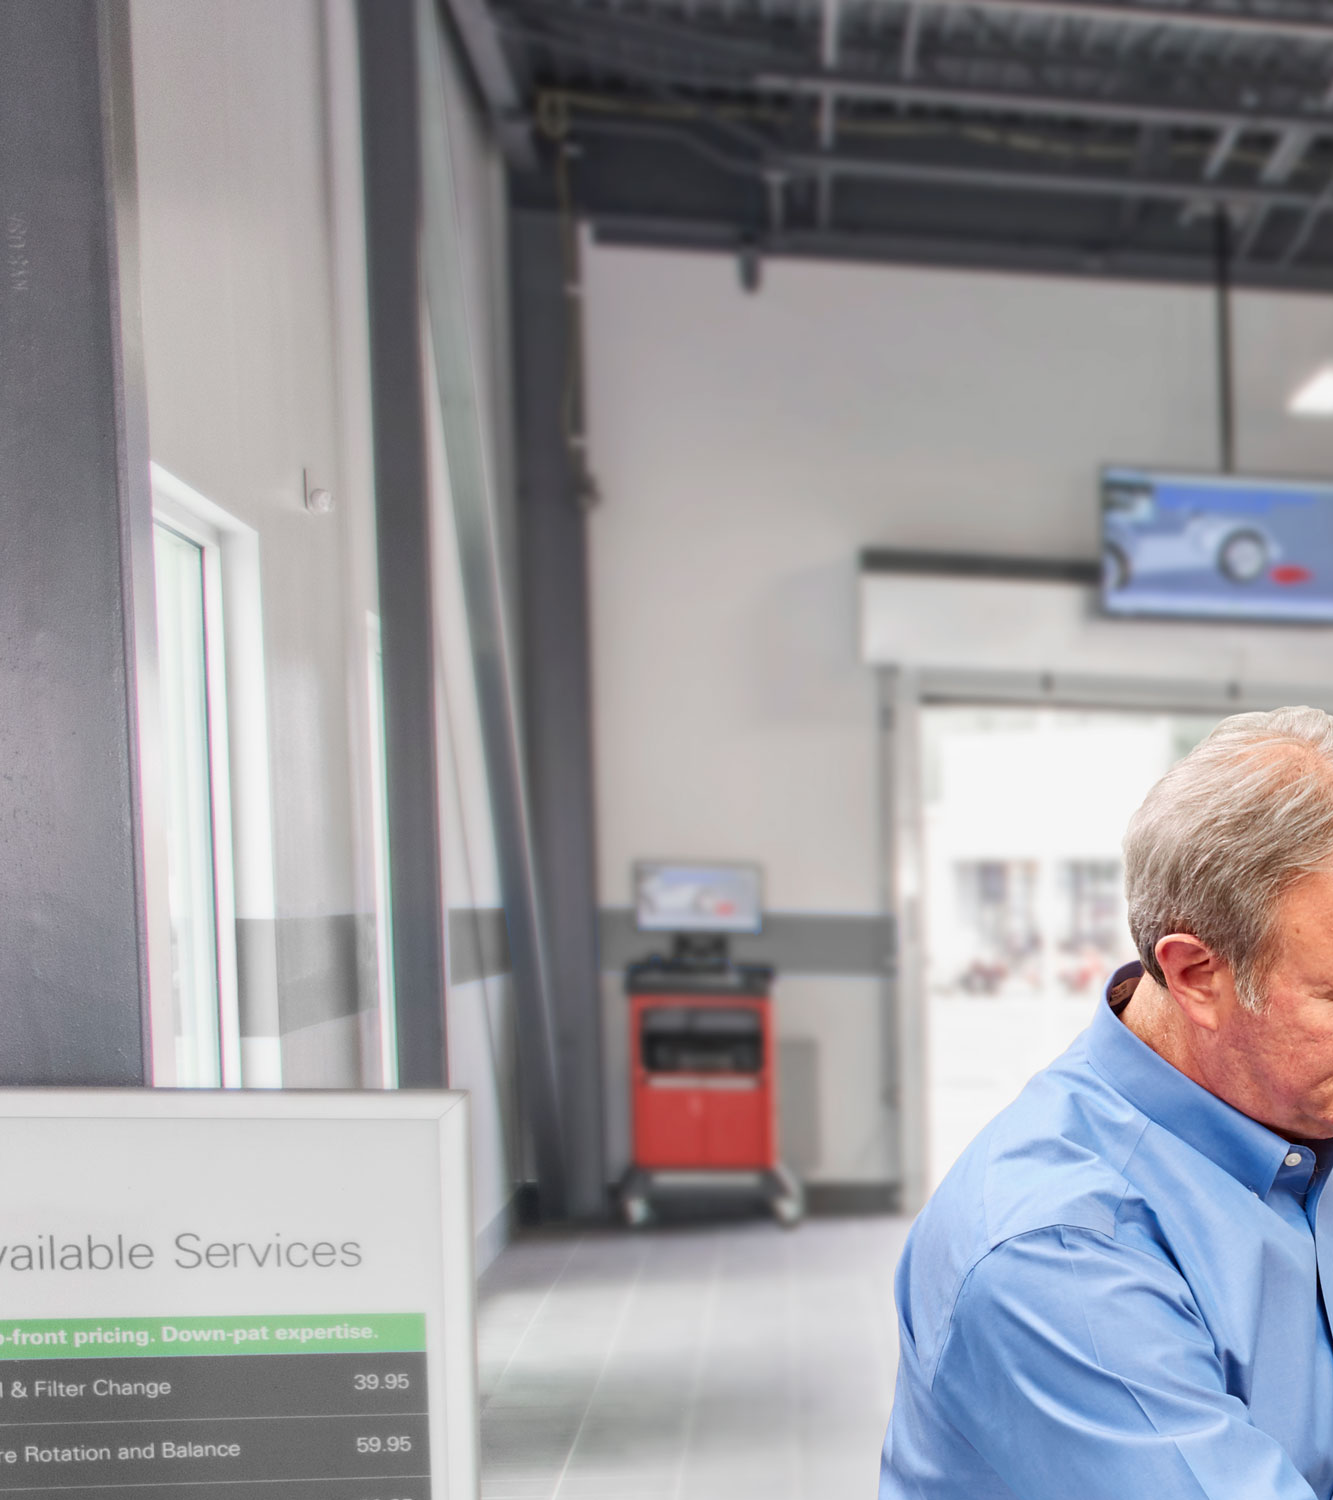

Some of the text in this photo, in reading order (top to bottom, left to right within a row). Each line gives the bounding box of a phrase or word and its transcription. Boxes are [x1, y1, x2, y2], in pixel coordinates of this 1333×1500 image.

[174, 1232, 362, 1269] Services
[74, 1327, 155, 1348] pricing.
[161, 1325, 270, 1345] Down-pat
[275, 1323, 379, 1344] expertise.
[11, 1381, 28, 1398] &
[35, 1380, 87, 1397] Filter
[93, 1379, 172, 1398] Change
[353, 1373, 410, 1390] 39.95
[25, 1445, 111, 1463] Rotation
[118, 1442, 155, 1460] and
[162, 1441, 241, 1459] Balance
[356, 1435, 412, 1453] 59.95
